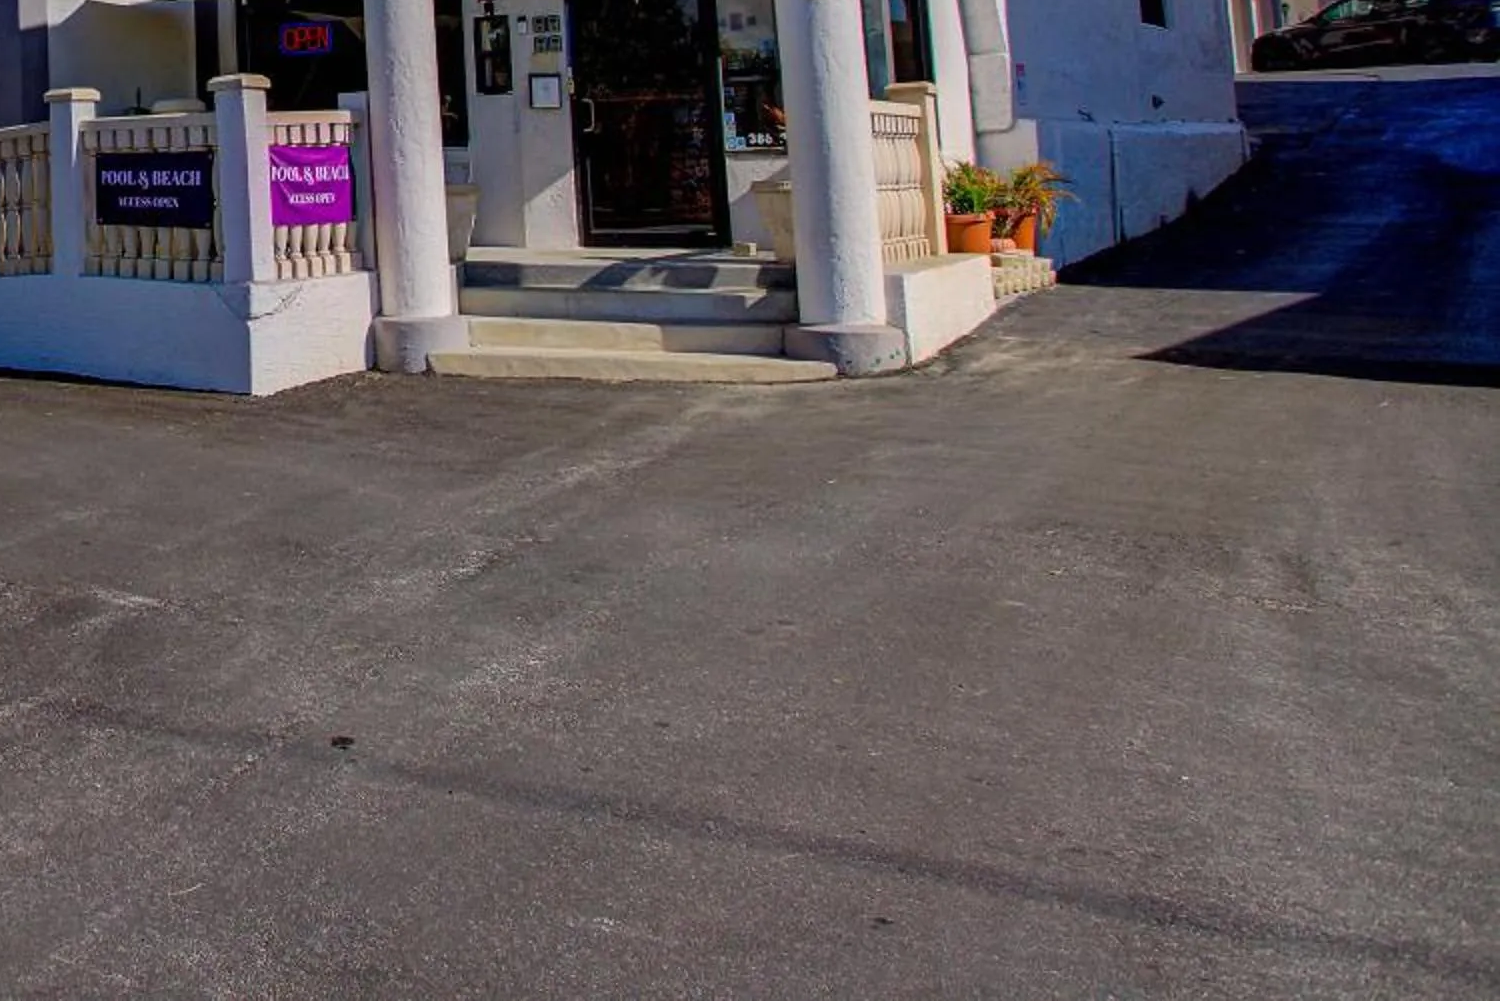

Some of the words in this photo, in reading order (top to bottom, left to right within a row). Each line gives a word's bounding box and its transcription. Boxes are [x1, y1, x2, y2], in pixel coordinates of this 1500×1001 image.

[101, 170, 137, 186] POOL
[138, 170, 150, 190] &
[152, 170, 202, 186] BEACH
[271, 166, 303, 181] POOL
